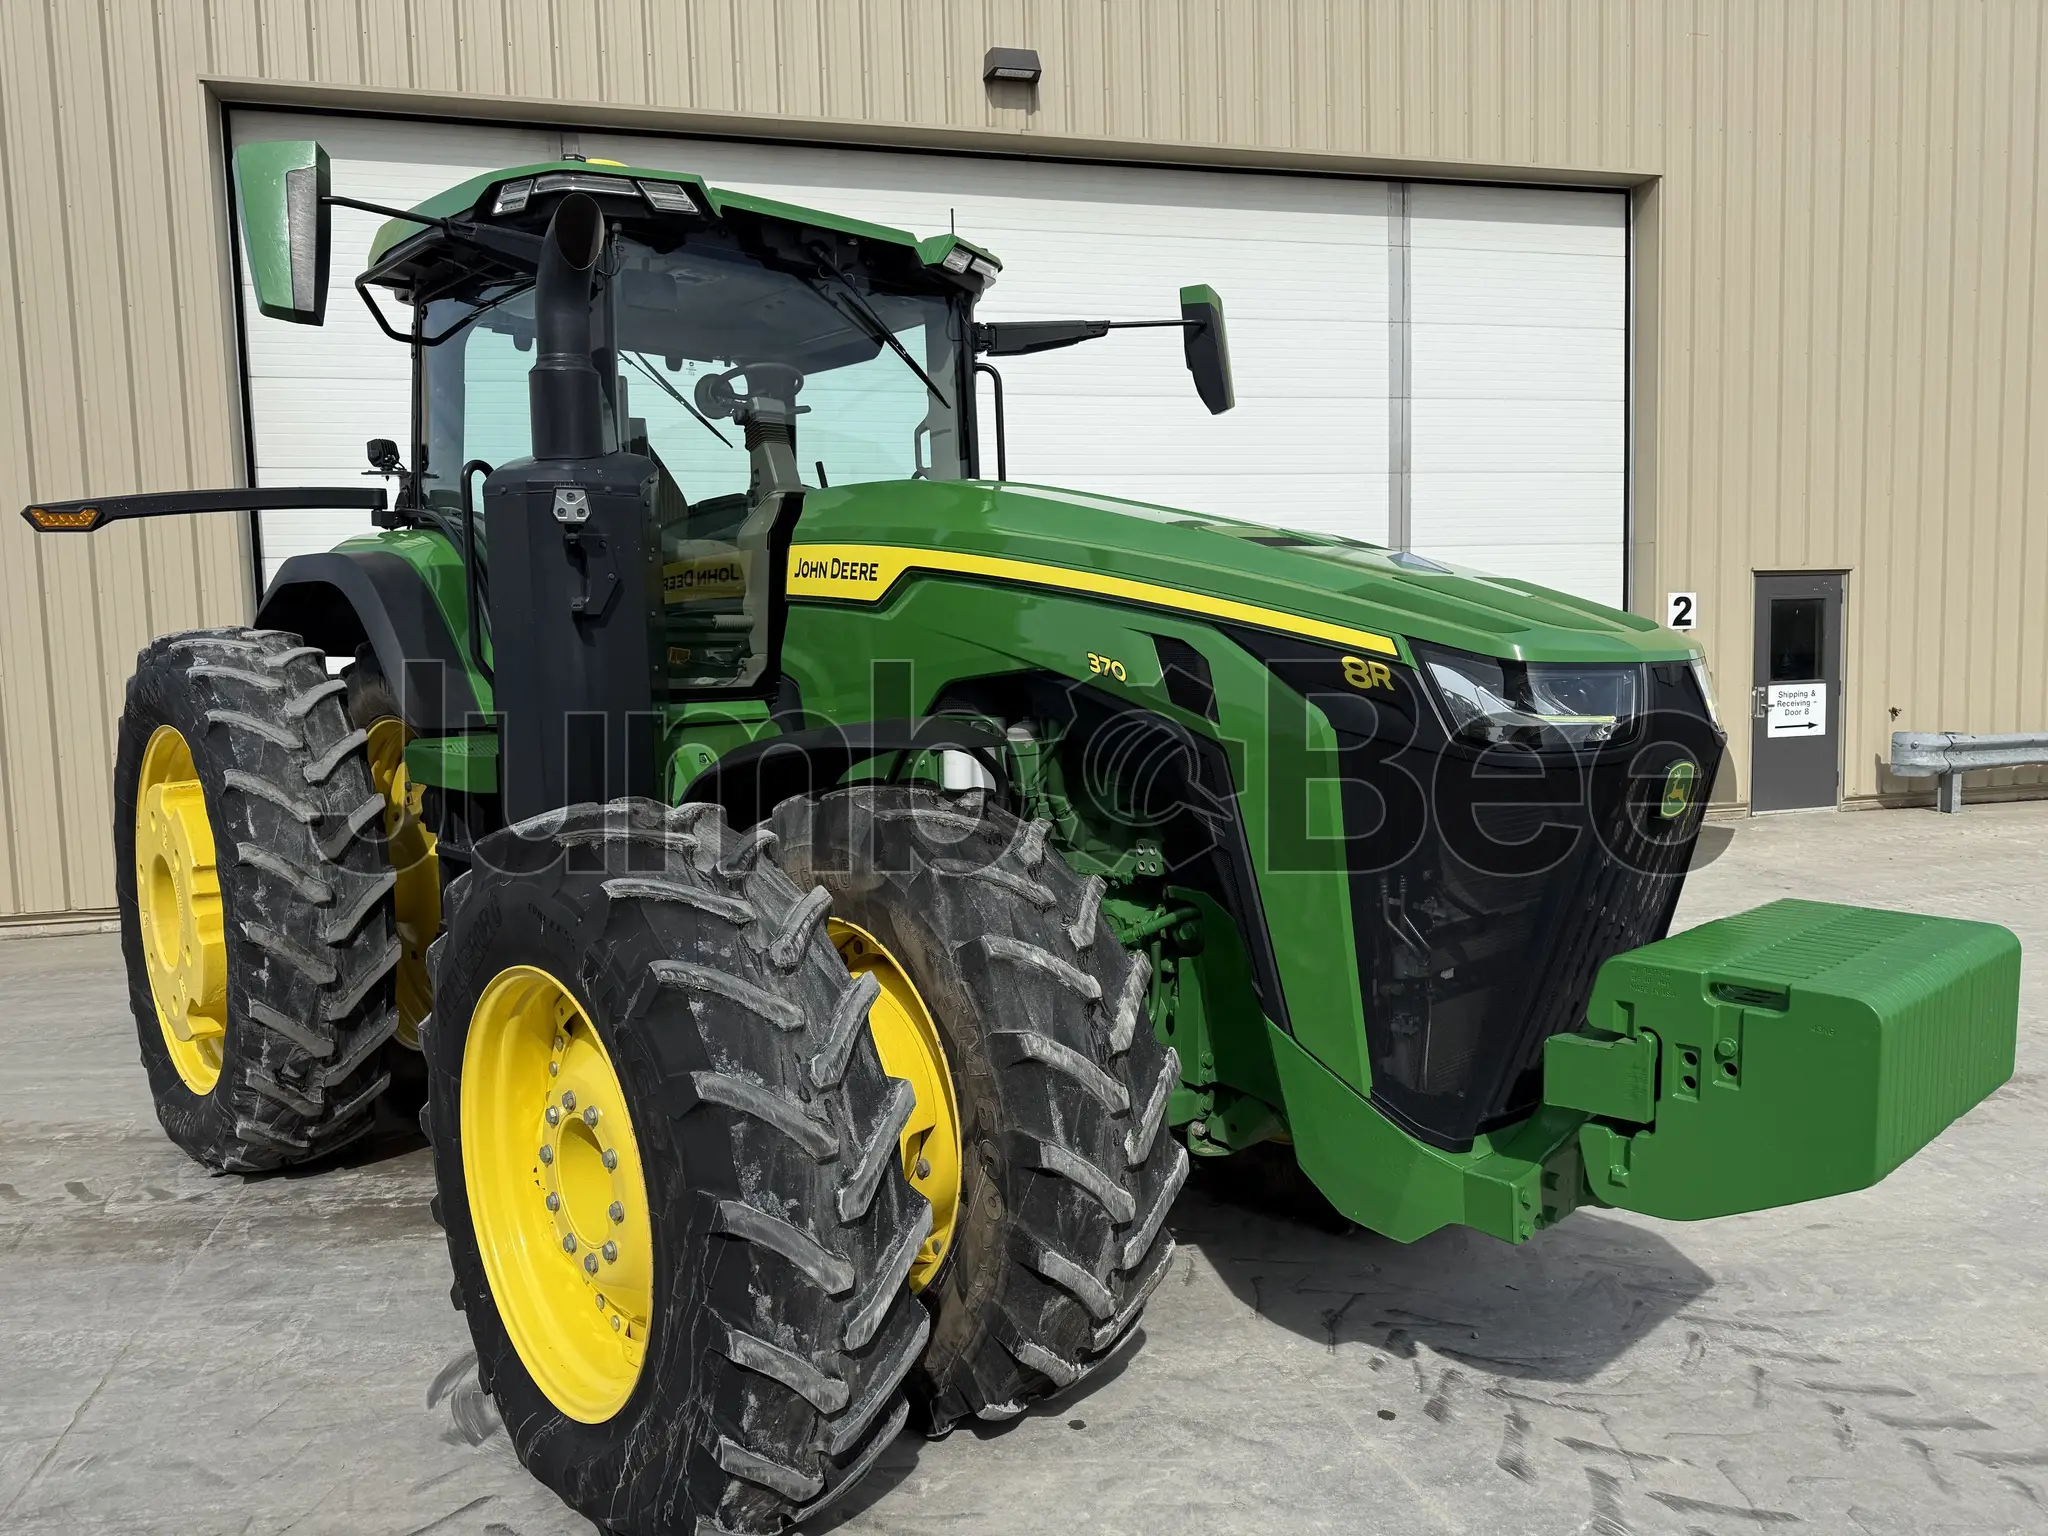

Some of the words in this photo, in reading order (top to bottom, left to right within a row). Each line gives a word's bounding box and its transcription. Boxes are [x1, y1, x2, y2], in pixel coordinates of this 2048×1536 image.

[794, 557, 829, 579] JOHN
[829, 557, 879, 582] DEERE
[1672, 596, 1692, 627] 2
[1086, 651, 1128, 682] 370
[1340, 655, 1396, 692] 8R
[1776, 700, 1811, 708] Receiving
[1778, 690, 1809, 700] Shipping
[1784, 708, 1802, 716] Door
